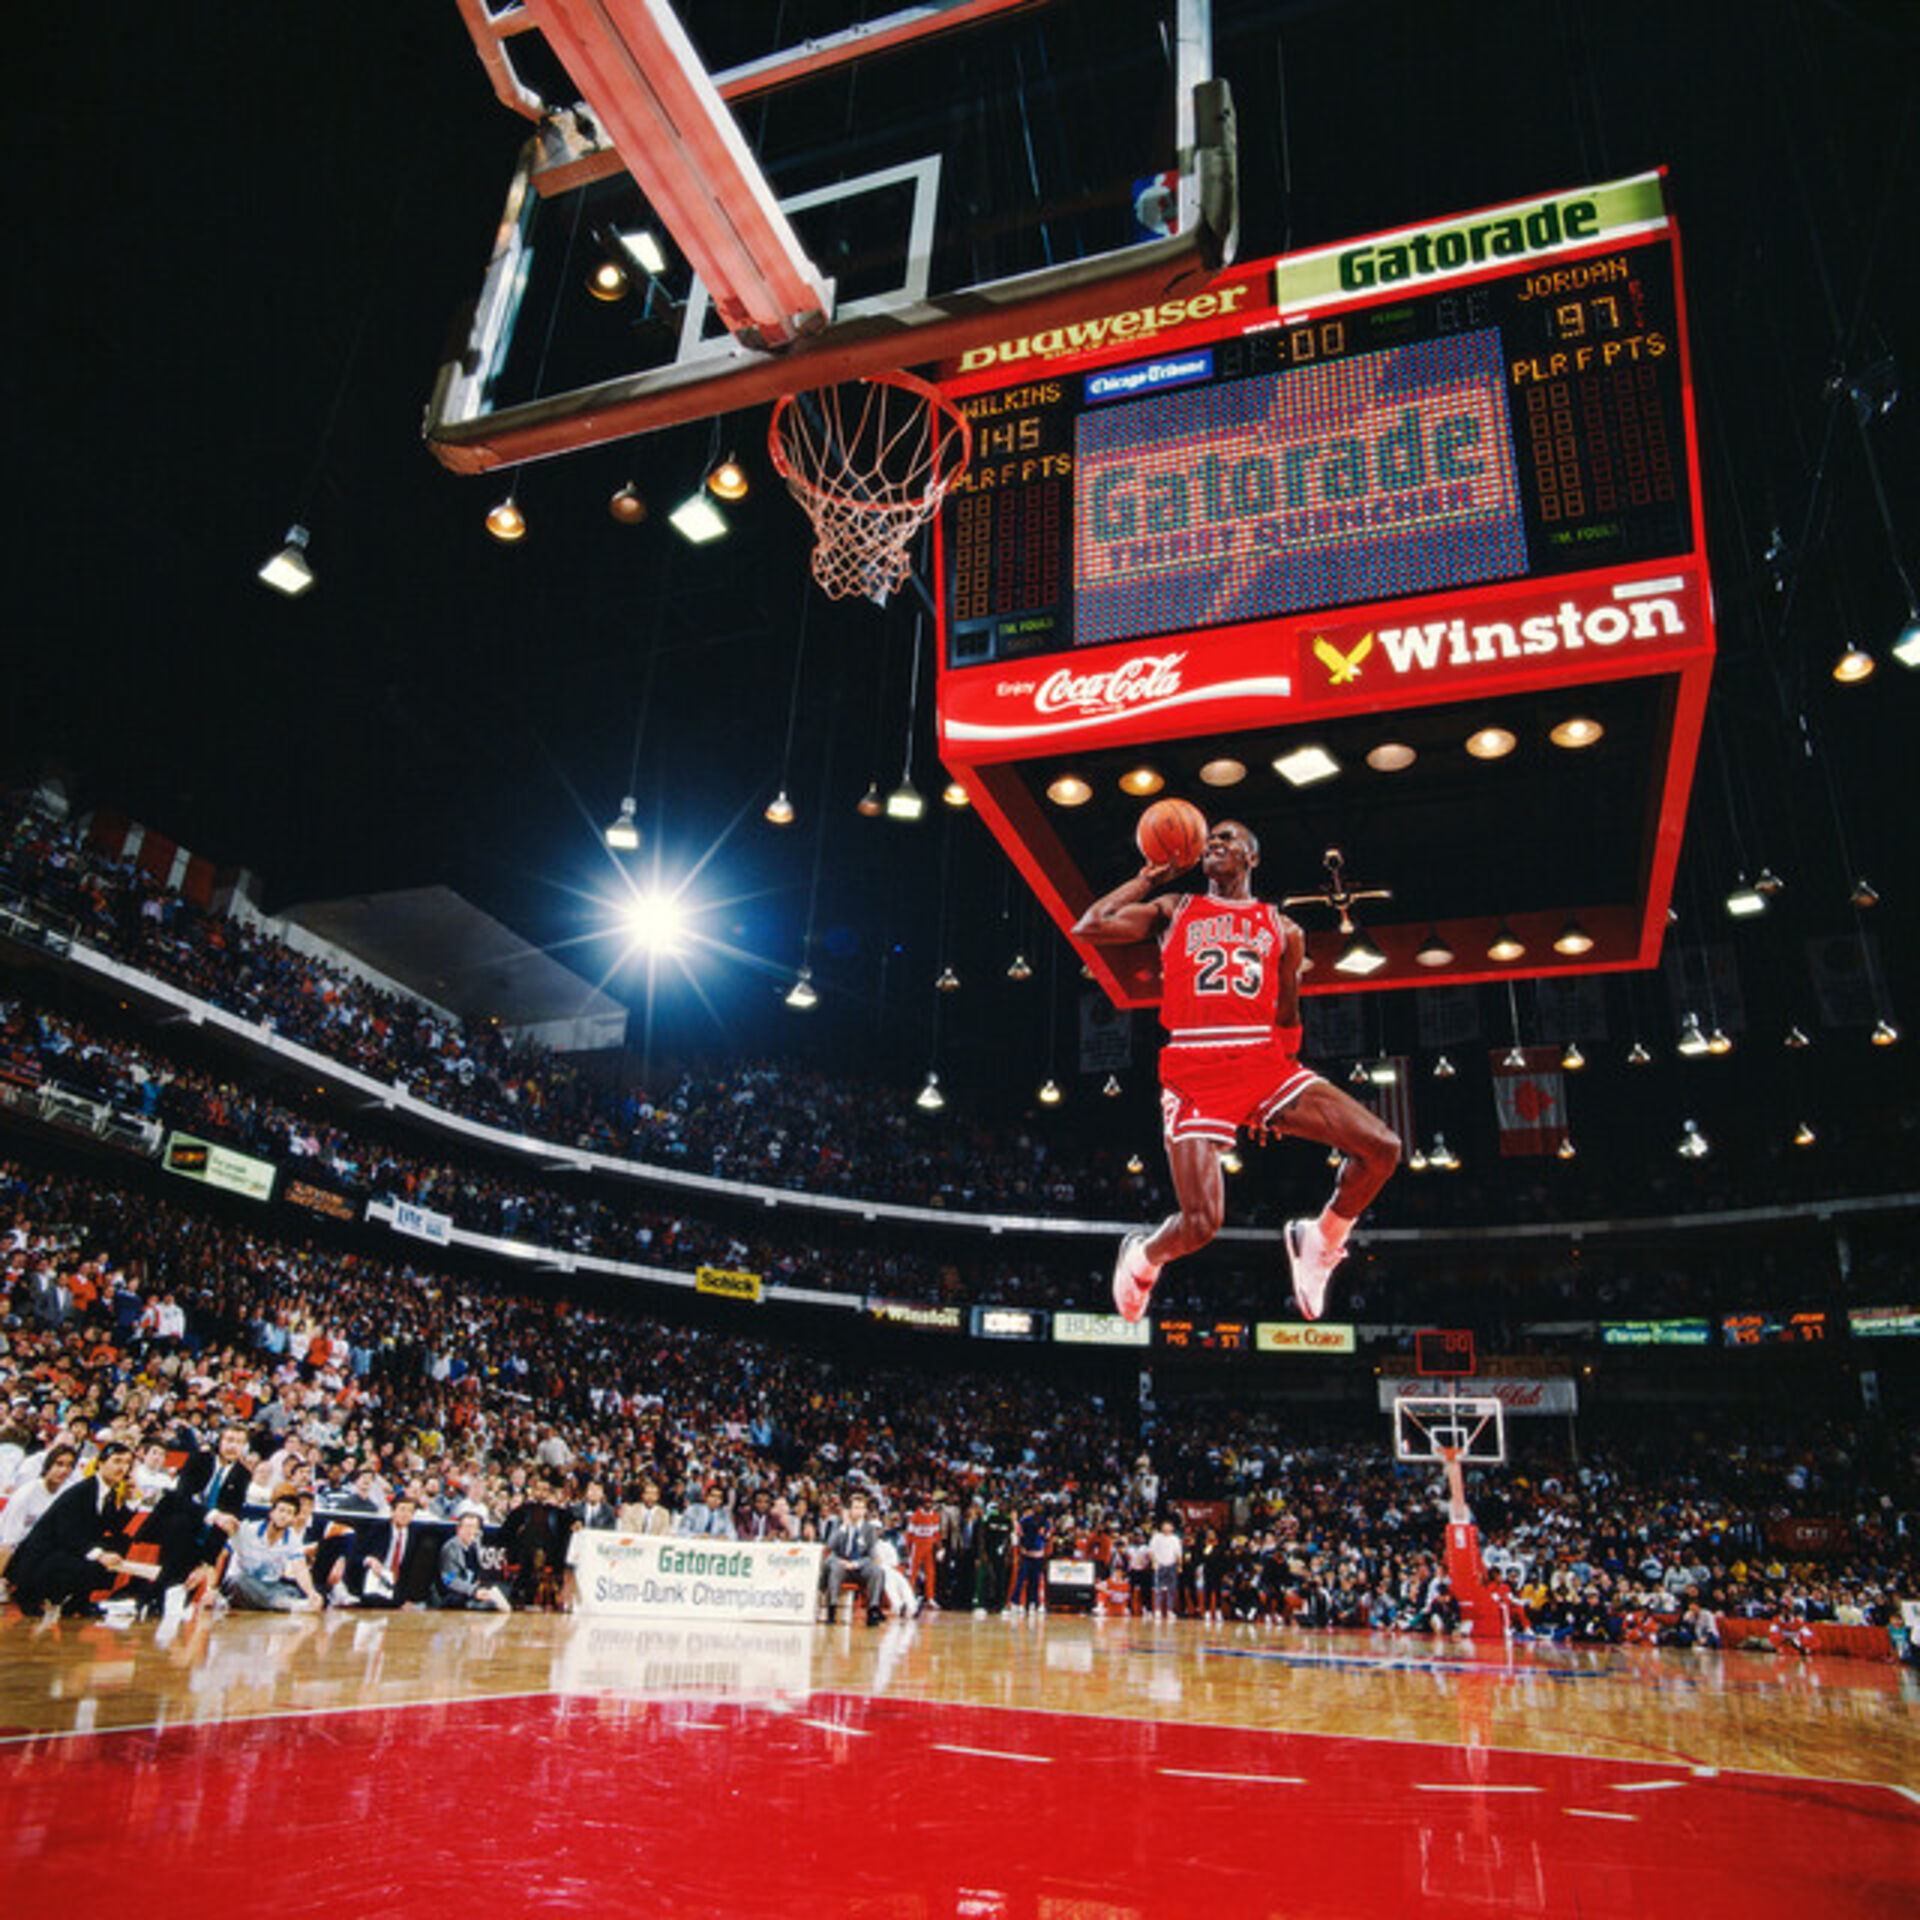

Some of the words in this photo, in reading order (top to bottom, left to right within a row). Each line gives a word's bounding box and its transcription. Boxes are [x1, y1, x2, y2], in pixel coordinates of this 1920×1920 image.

[1339, 198, 1599, 291] Gatorade
[1518, 257, 1629, 300] JORDAN
[1556, 296, 1620, 339] 97
[1089, 370, 1149, 394] Chicago
[1147, 358, 1207, 383] Tribune
[1513, 354, 1568, 385] PLR
[1576, 347, 1594, 370] F
[1603, 332, 1667, 366] PTS
[961, 382, 1062, 418] WILKINS
[980, 417, 1040, 457] 145
[1001, 462, 1016, 484] F
[1022, 453, 1072, 481] PTS
[1091, 408, 1485, 542] Gatorade
[1378, 597, 1686, 674] Winston
[1034, 650, 1189, 713] Coca-Cola
[1185, 913, 1274, 957] BULLS
[1194, 948, 1264, 999] 23
[658, 1545, 754, 1578] Gatorade
[595, 1576, 688, 1604] Slam-Dunk
[692, 1582, 806, 1612] Championship
